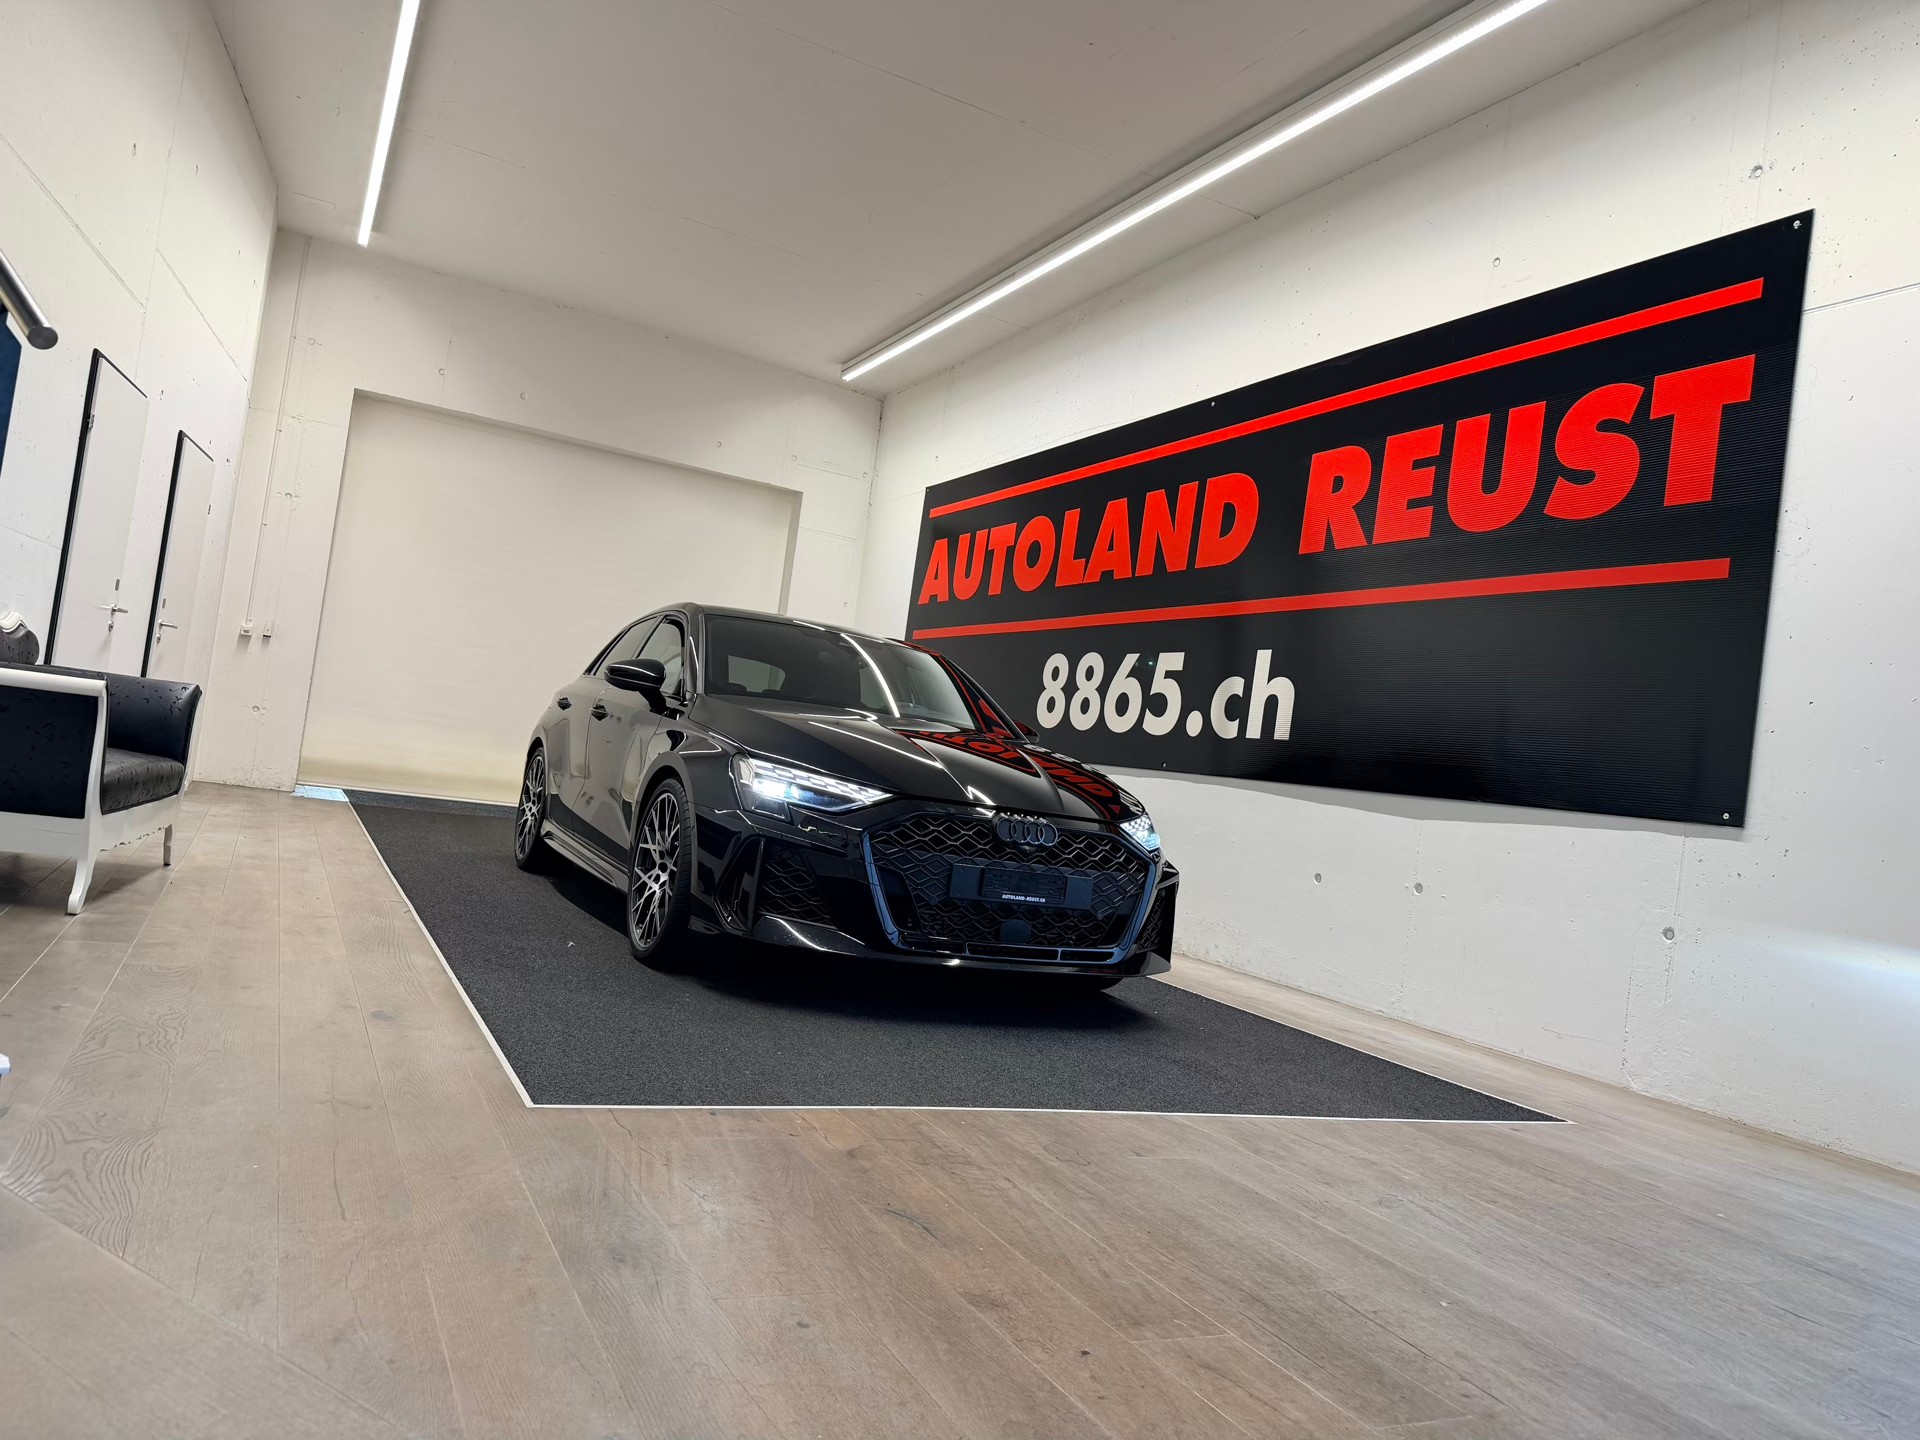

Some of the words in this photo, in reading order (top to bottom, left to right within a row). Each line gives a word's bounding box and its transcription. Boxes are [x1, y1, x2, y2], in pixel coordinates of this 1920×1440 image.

[918, 473, 1260, 605] AUTOLAND
[1299, 354, 1756, 555] REUST
[1036, 649, 1296, 741] 8865.ch
